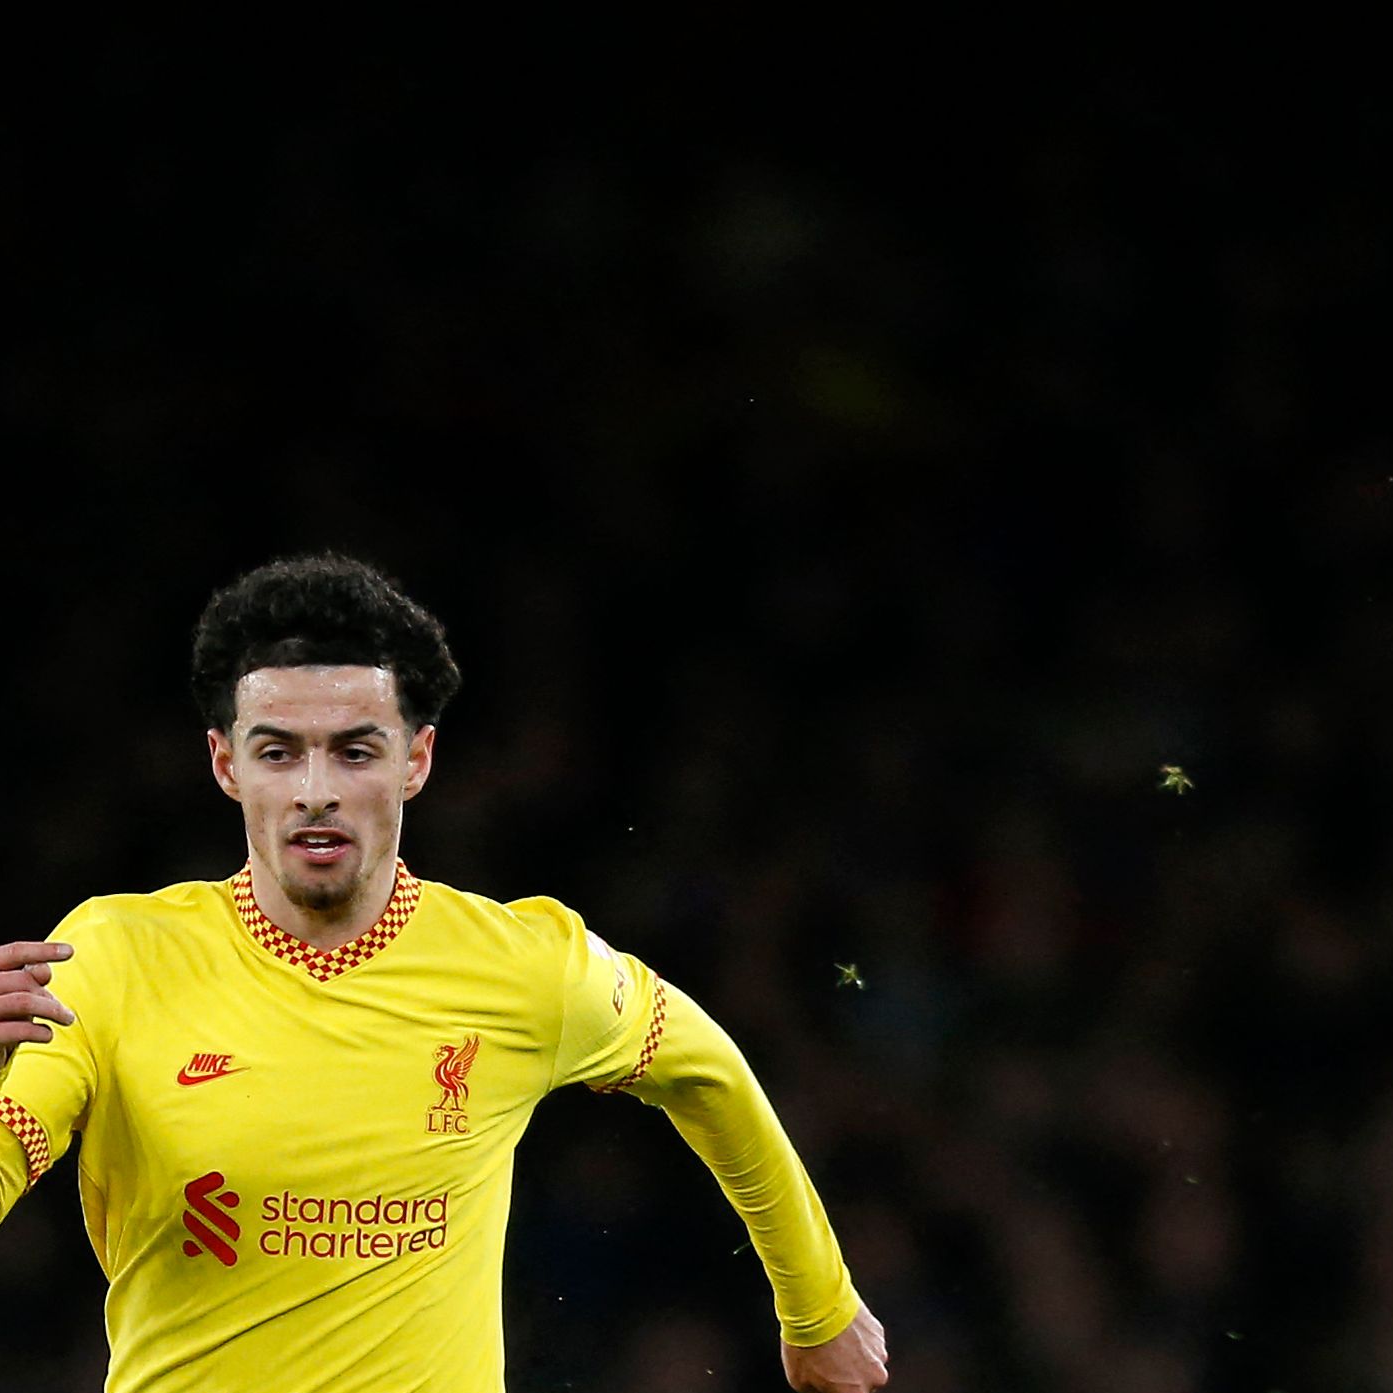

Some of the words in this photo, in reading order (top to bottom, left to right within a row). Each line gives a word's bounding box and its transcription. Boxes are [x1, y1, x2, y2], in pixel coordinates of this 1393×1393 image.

[188, 1053, 232, 1073] NIKE
[262, 1192, 449, 1226] standard
[260, 1224, 447, 1259] chartered
